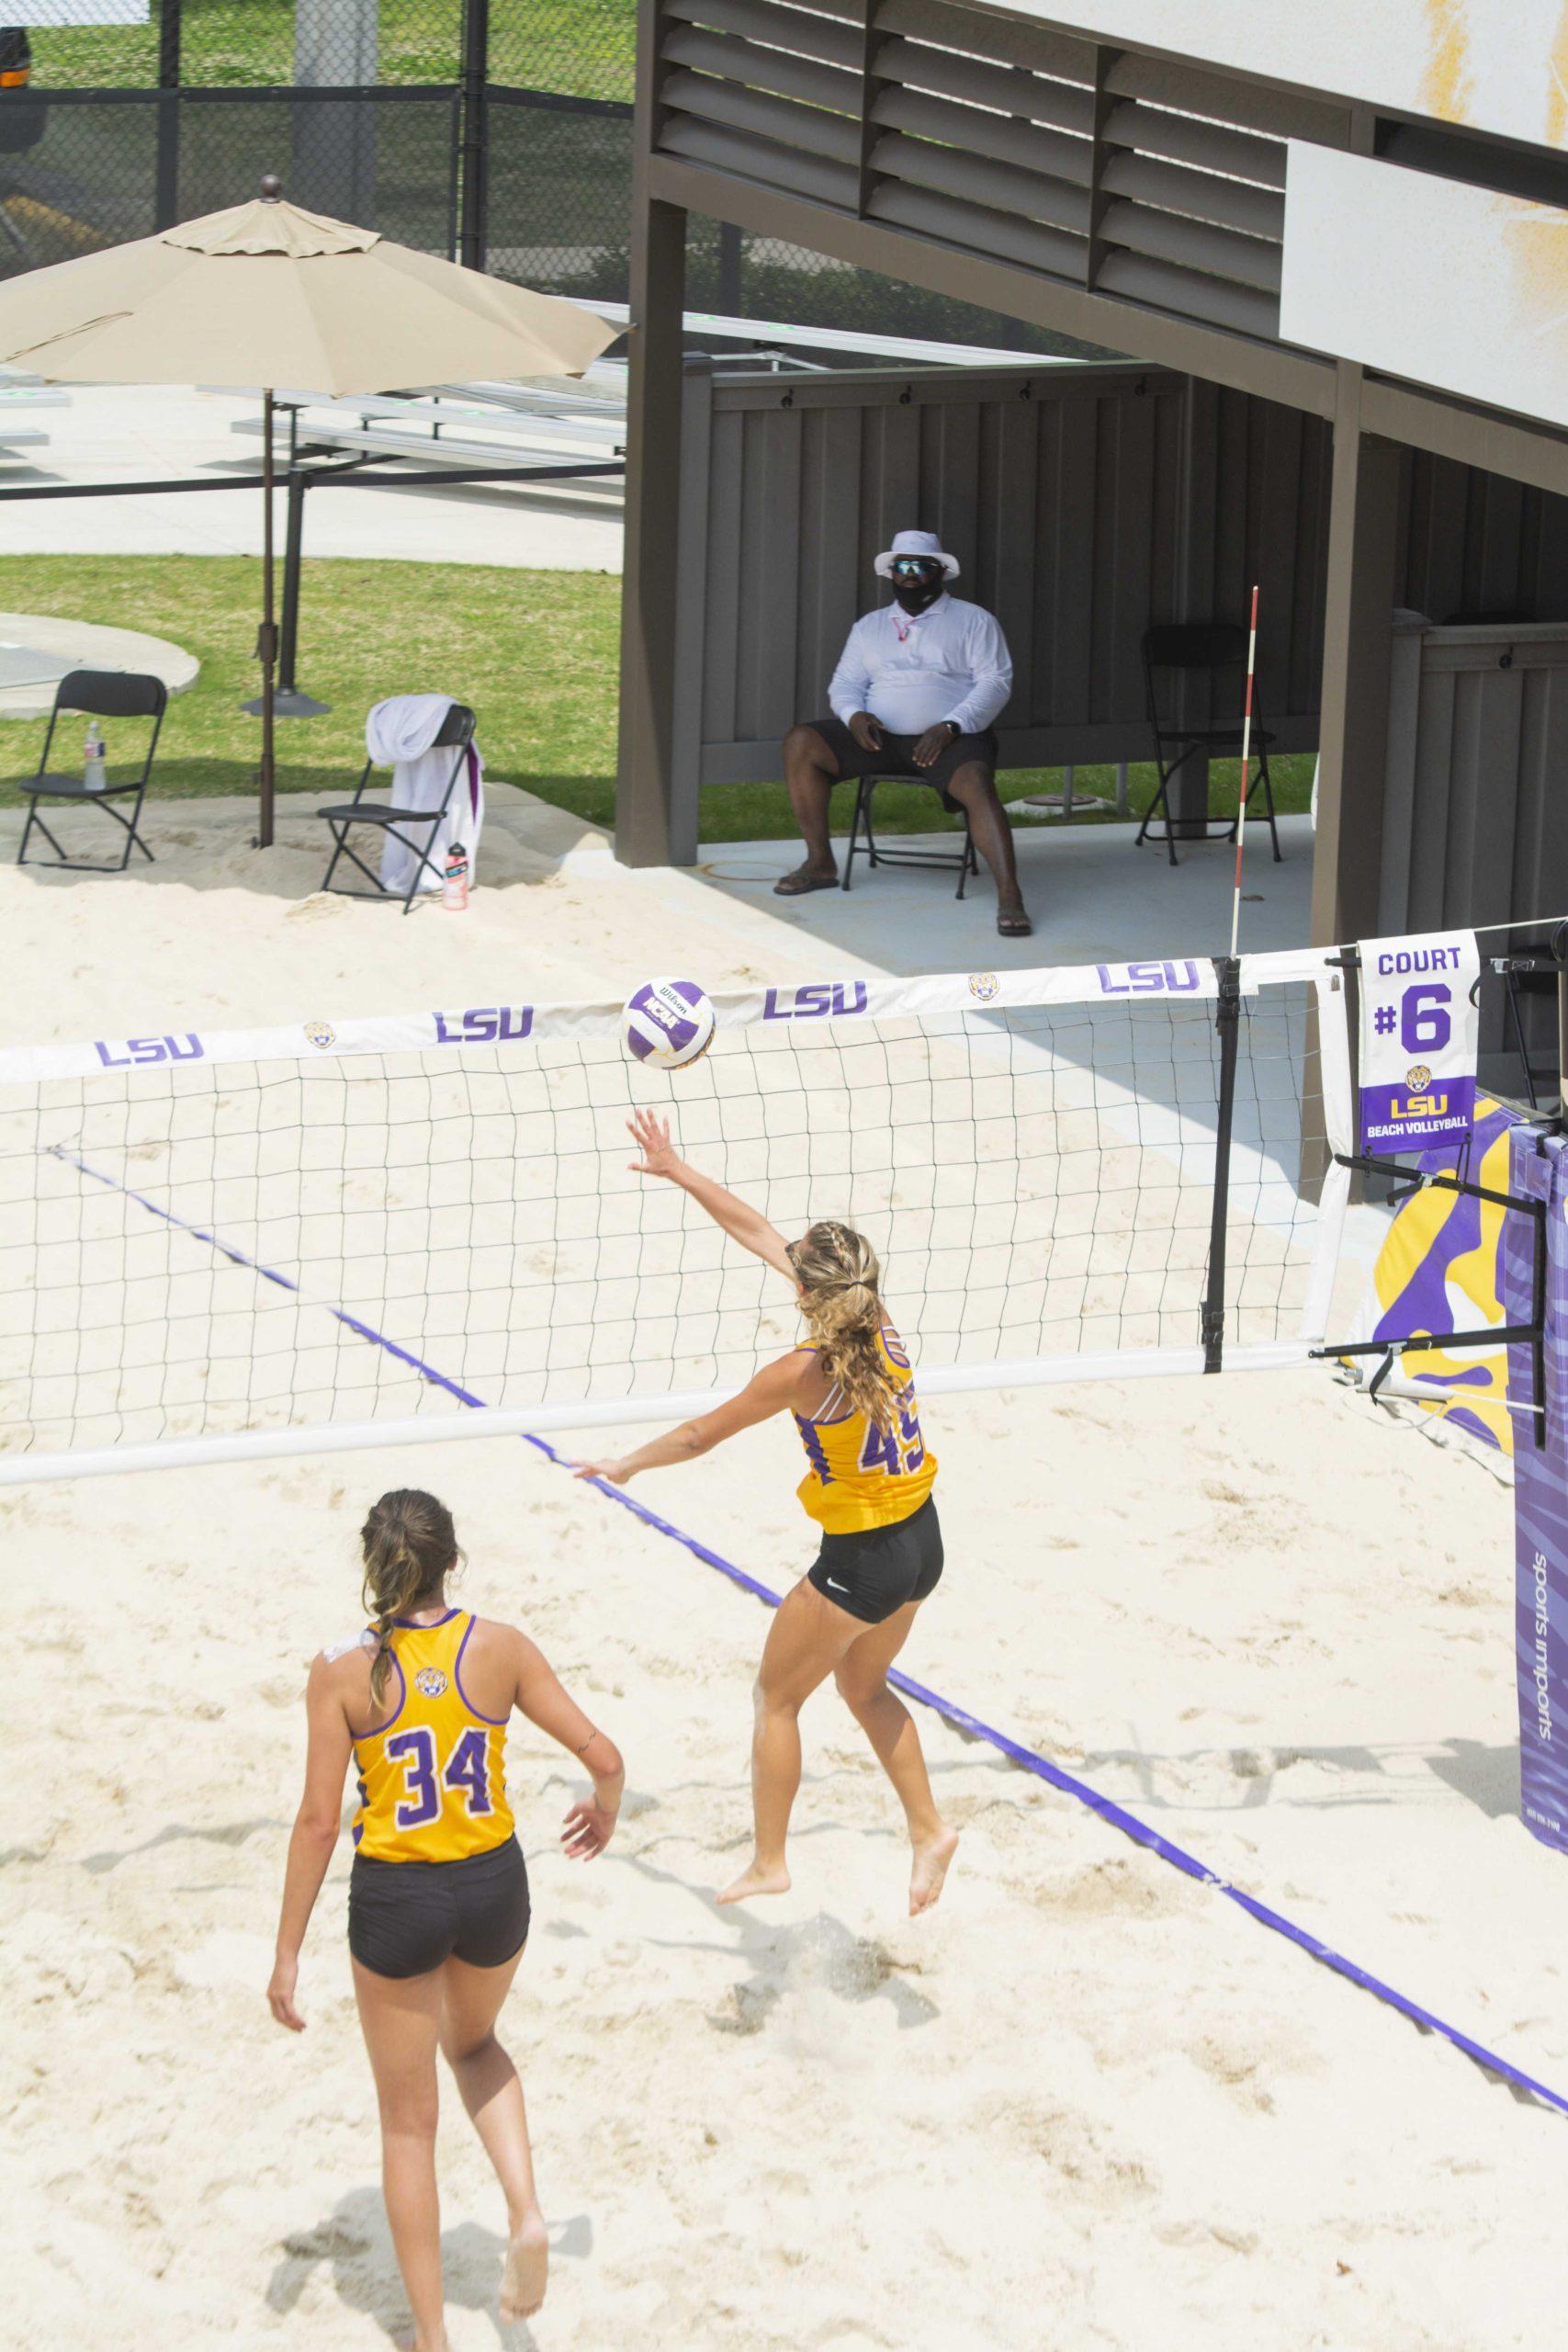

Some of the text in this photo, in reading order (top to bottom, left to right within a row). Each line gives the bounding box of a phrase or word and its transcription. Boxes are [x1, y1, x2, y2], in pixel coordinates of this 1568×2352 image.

[1097, 960, 1201, 994] LSU
[1378, 947, 1461, 976] COURT
[642, 996, 680, 1030] NCAA
[660, 987, 688, 1015] Wilson
[762, 980, 868, 1021] LSU
[434, 1005, 535, 1044] LSU
[1373, 983, 1452, 1054] #6
[95, 1034, 205, 1066] LSU
[1391, 1094, 1449, 1119] LSU
[1367, 1115, 1469, 1138] BEACH VOLLEYBALL
[857, 1377, 926, 1476] 45
[1532, 1551, 1553, 1742] sports imports
[383, 1724, 495, 1832] 34
